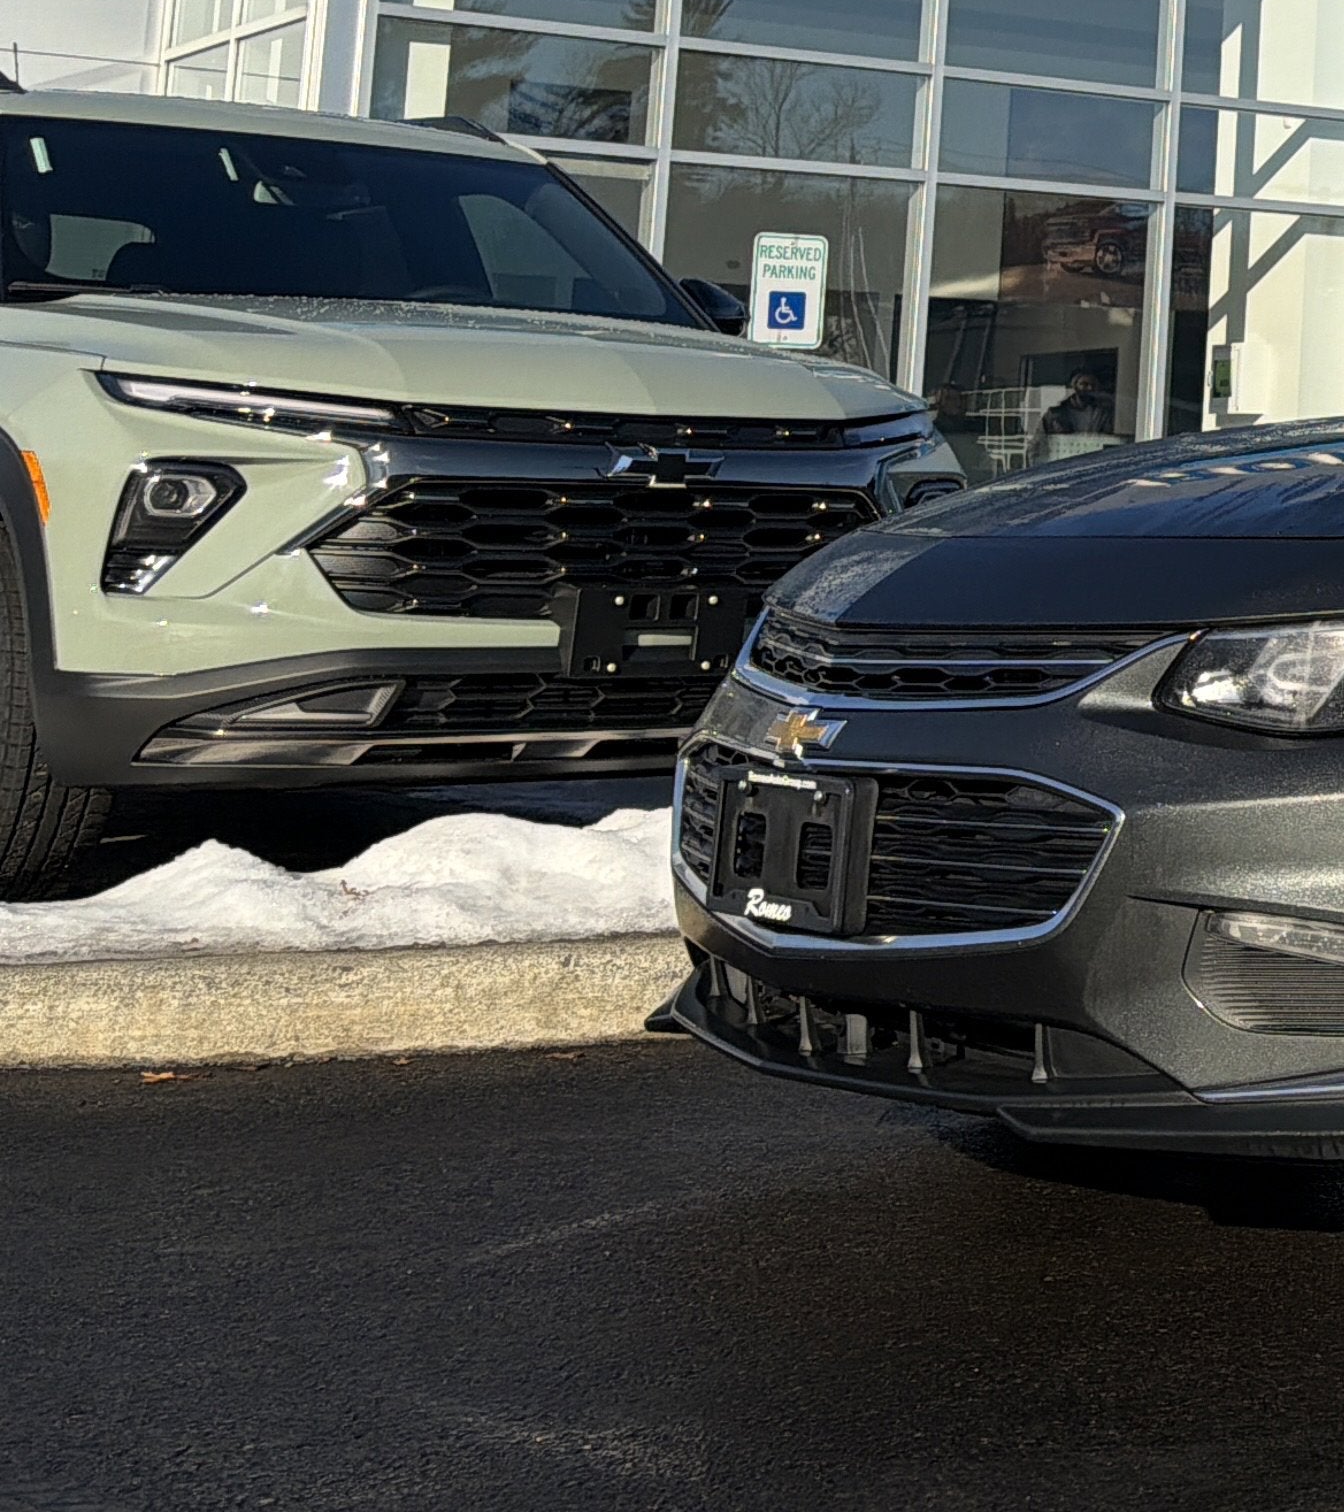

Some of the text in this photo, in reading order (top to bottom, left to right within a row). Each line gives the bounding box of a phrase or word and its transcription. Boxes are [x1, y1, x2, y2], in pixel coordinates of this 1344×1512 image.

[759, 244, 822, 262] RESERVED
[762, 263, 816, 280] PARKING
[744, 888, 792, 921] Romeo
